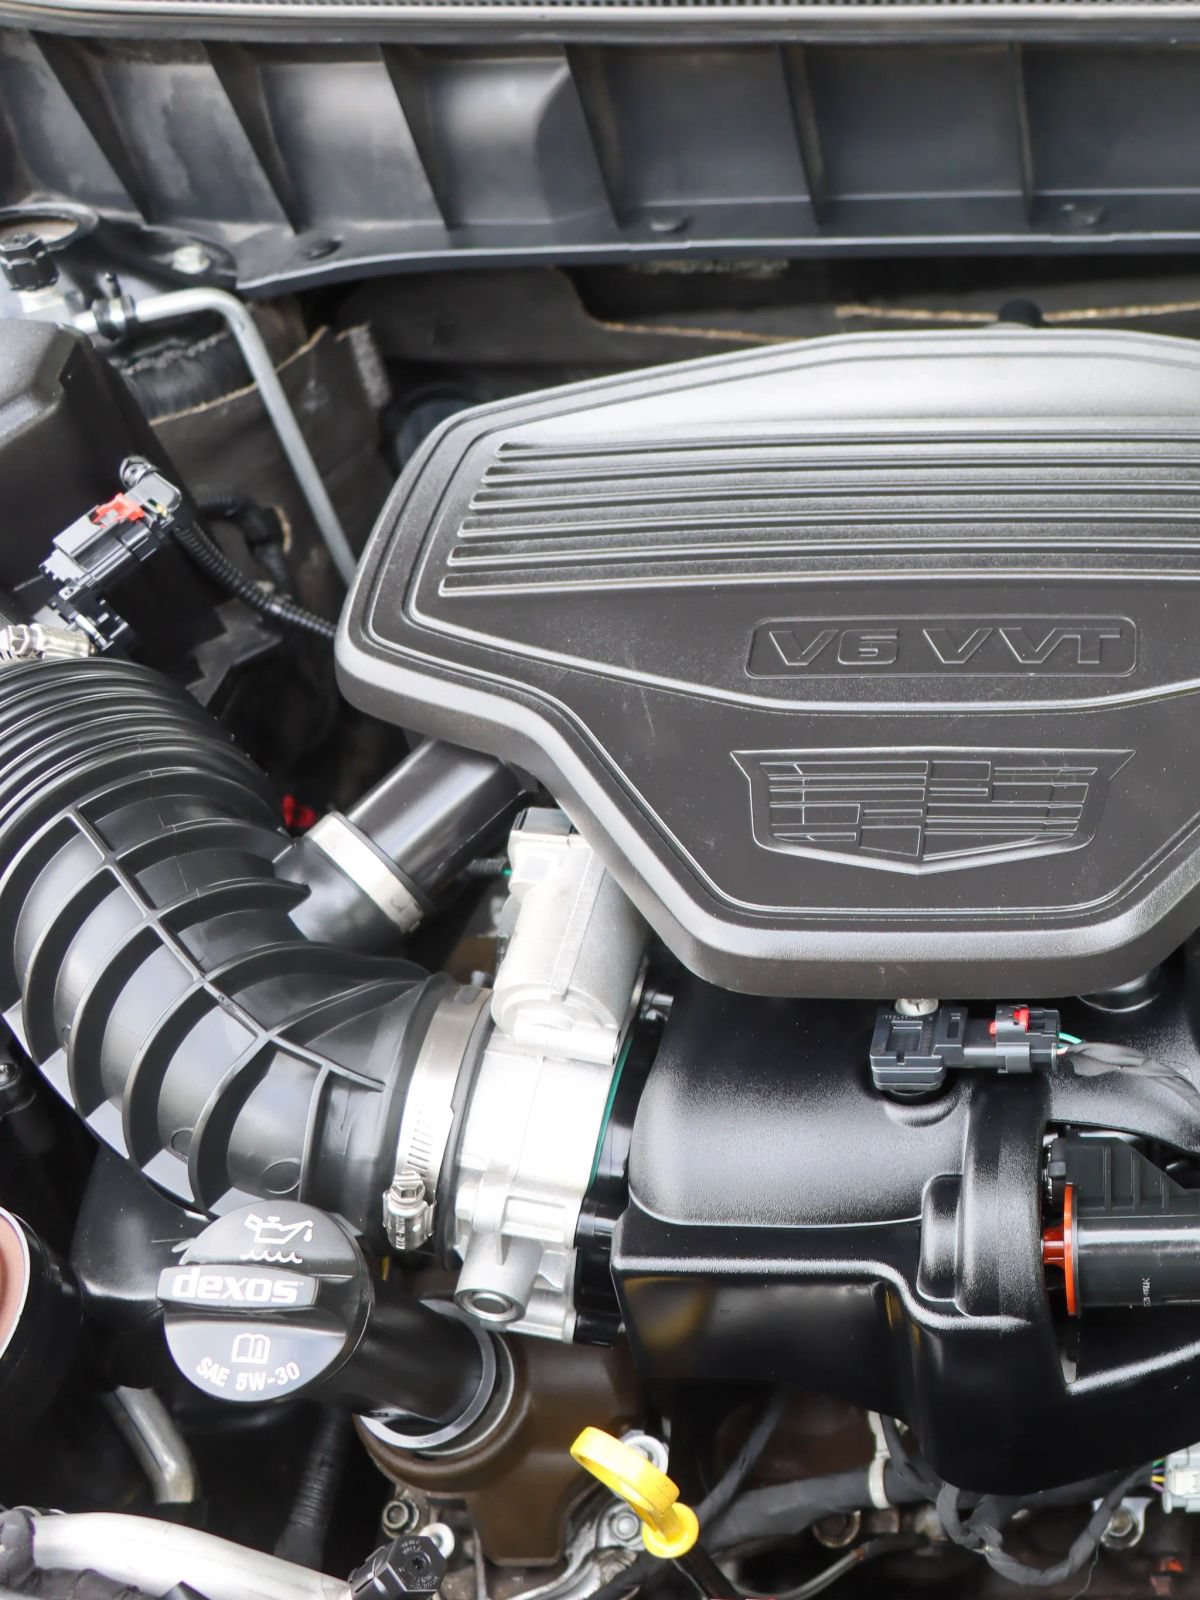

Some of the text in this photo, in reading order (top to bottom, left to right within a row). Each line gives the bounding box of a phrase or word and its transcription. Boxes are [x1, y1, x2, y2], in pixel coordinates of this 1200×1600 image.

[769, 627, 1121, 666] V6 VVT
[172, 1268, 299, 1304] dexos
[196, 1357, 300, 1391] SAE 5W-30
